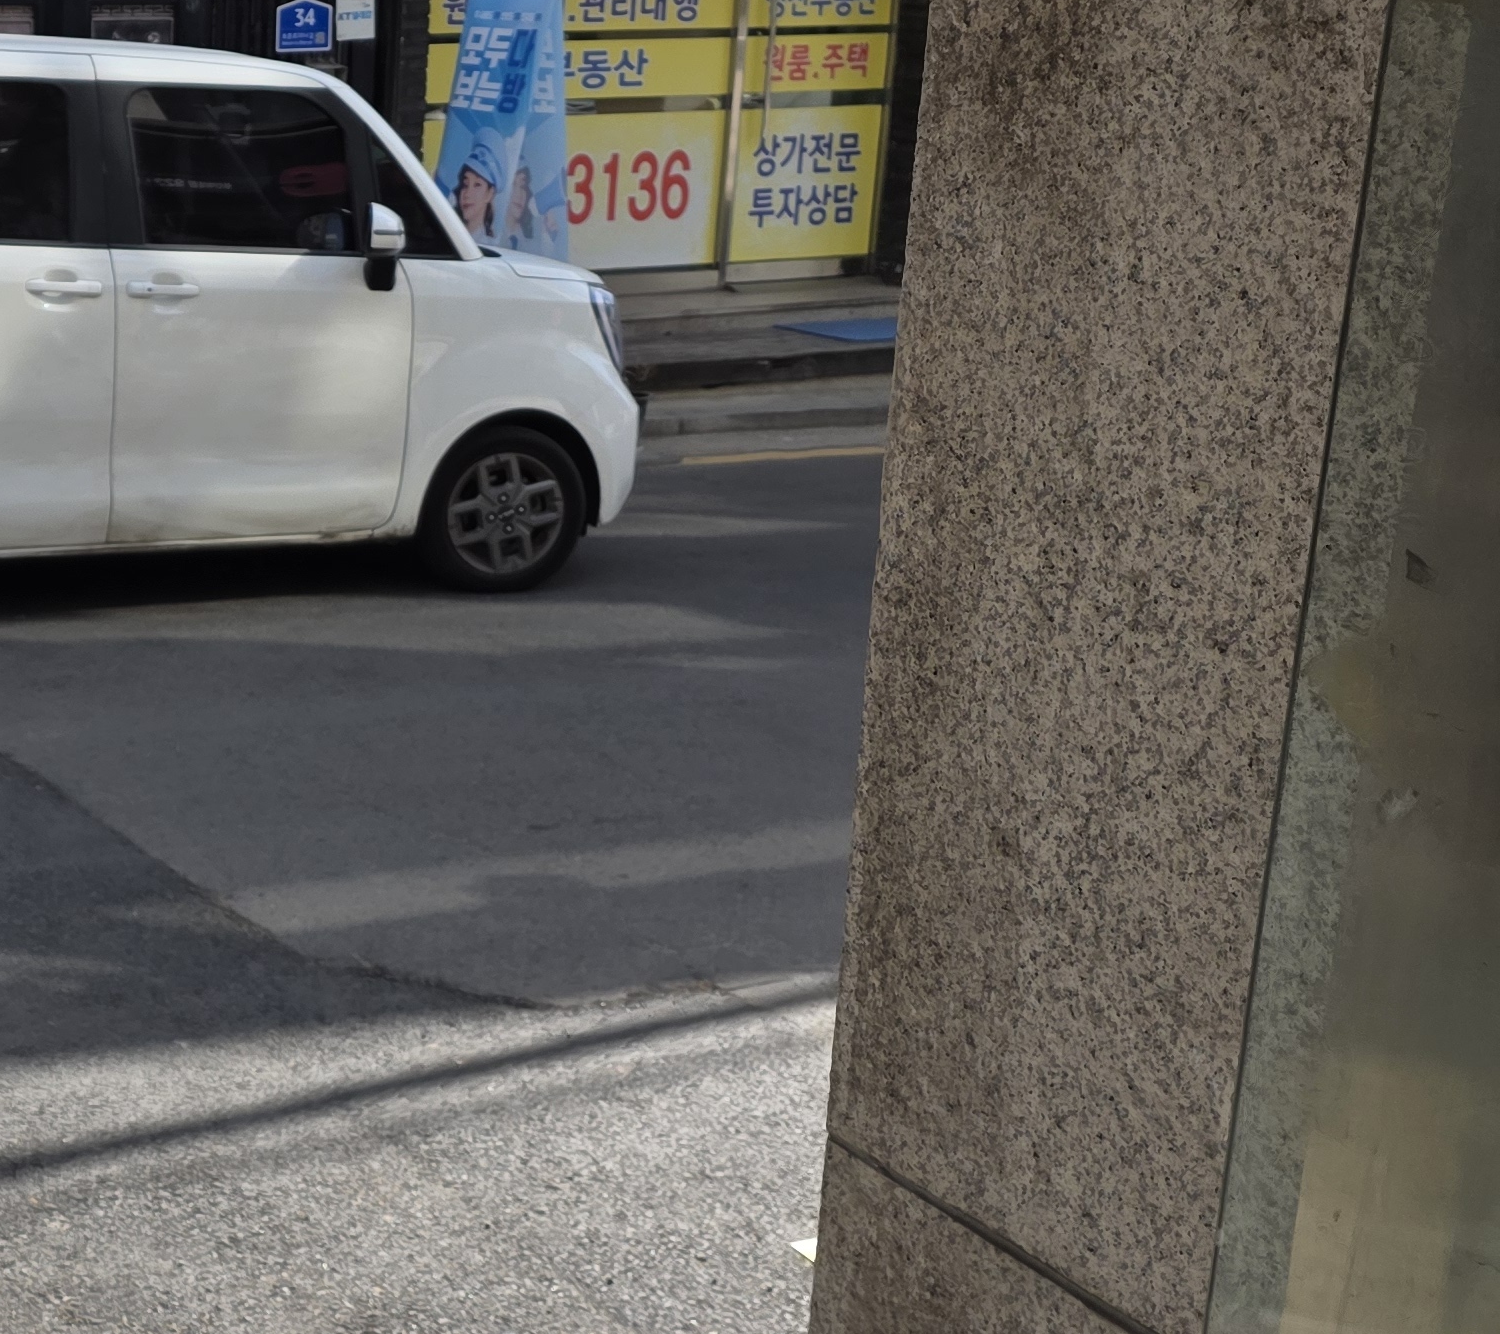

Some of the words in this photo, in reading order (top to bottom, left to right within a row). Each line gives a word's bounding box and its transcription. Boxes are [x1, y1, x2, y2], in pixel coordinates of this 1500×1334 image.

[294, 8, 316, 28] 34
[753, 132, 861, 178] 상가전문
[566, 148, 692, 225] 3136
[747, 182, 858, 228] 투자상담
